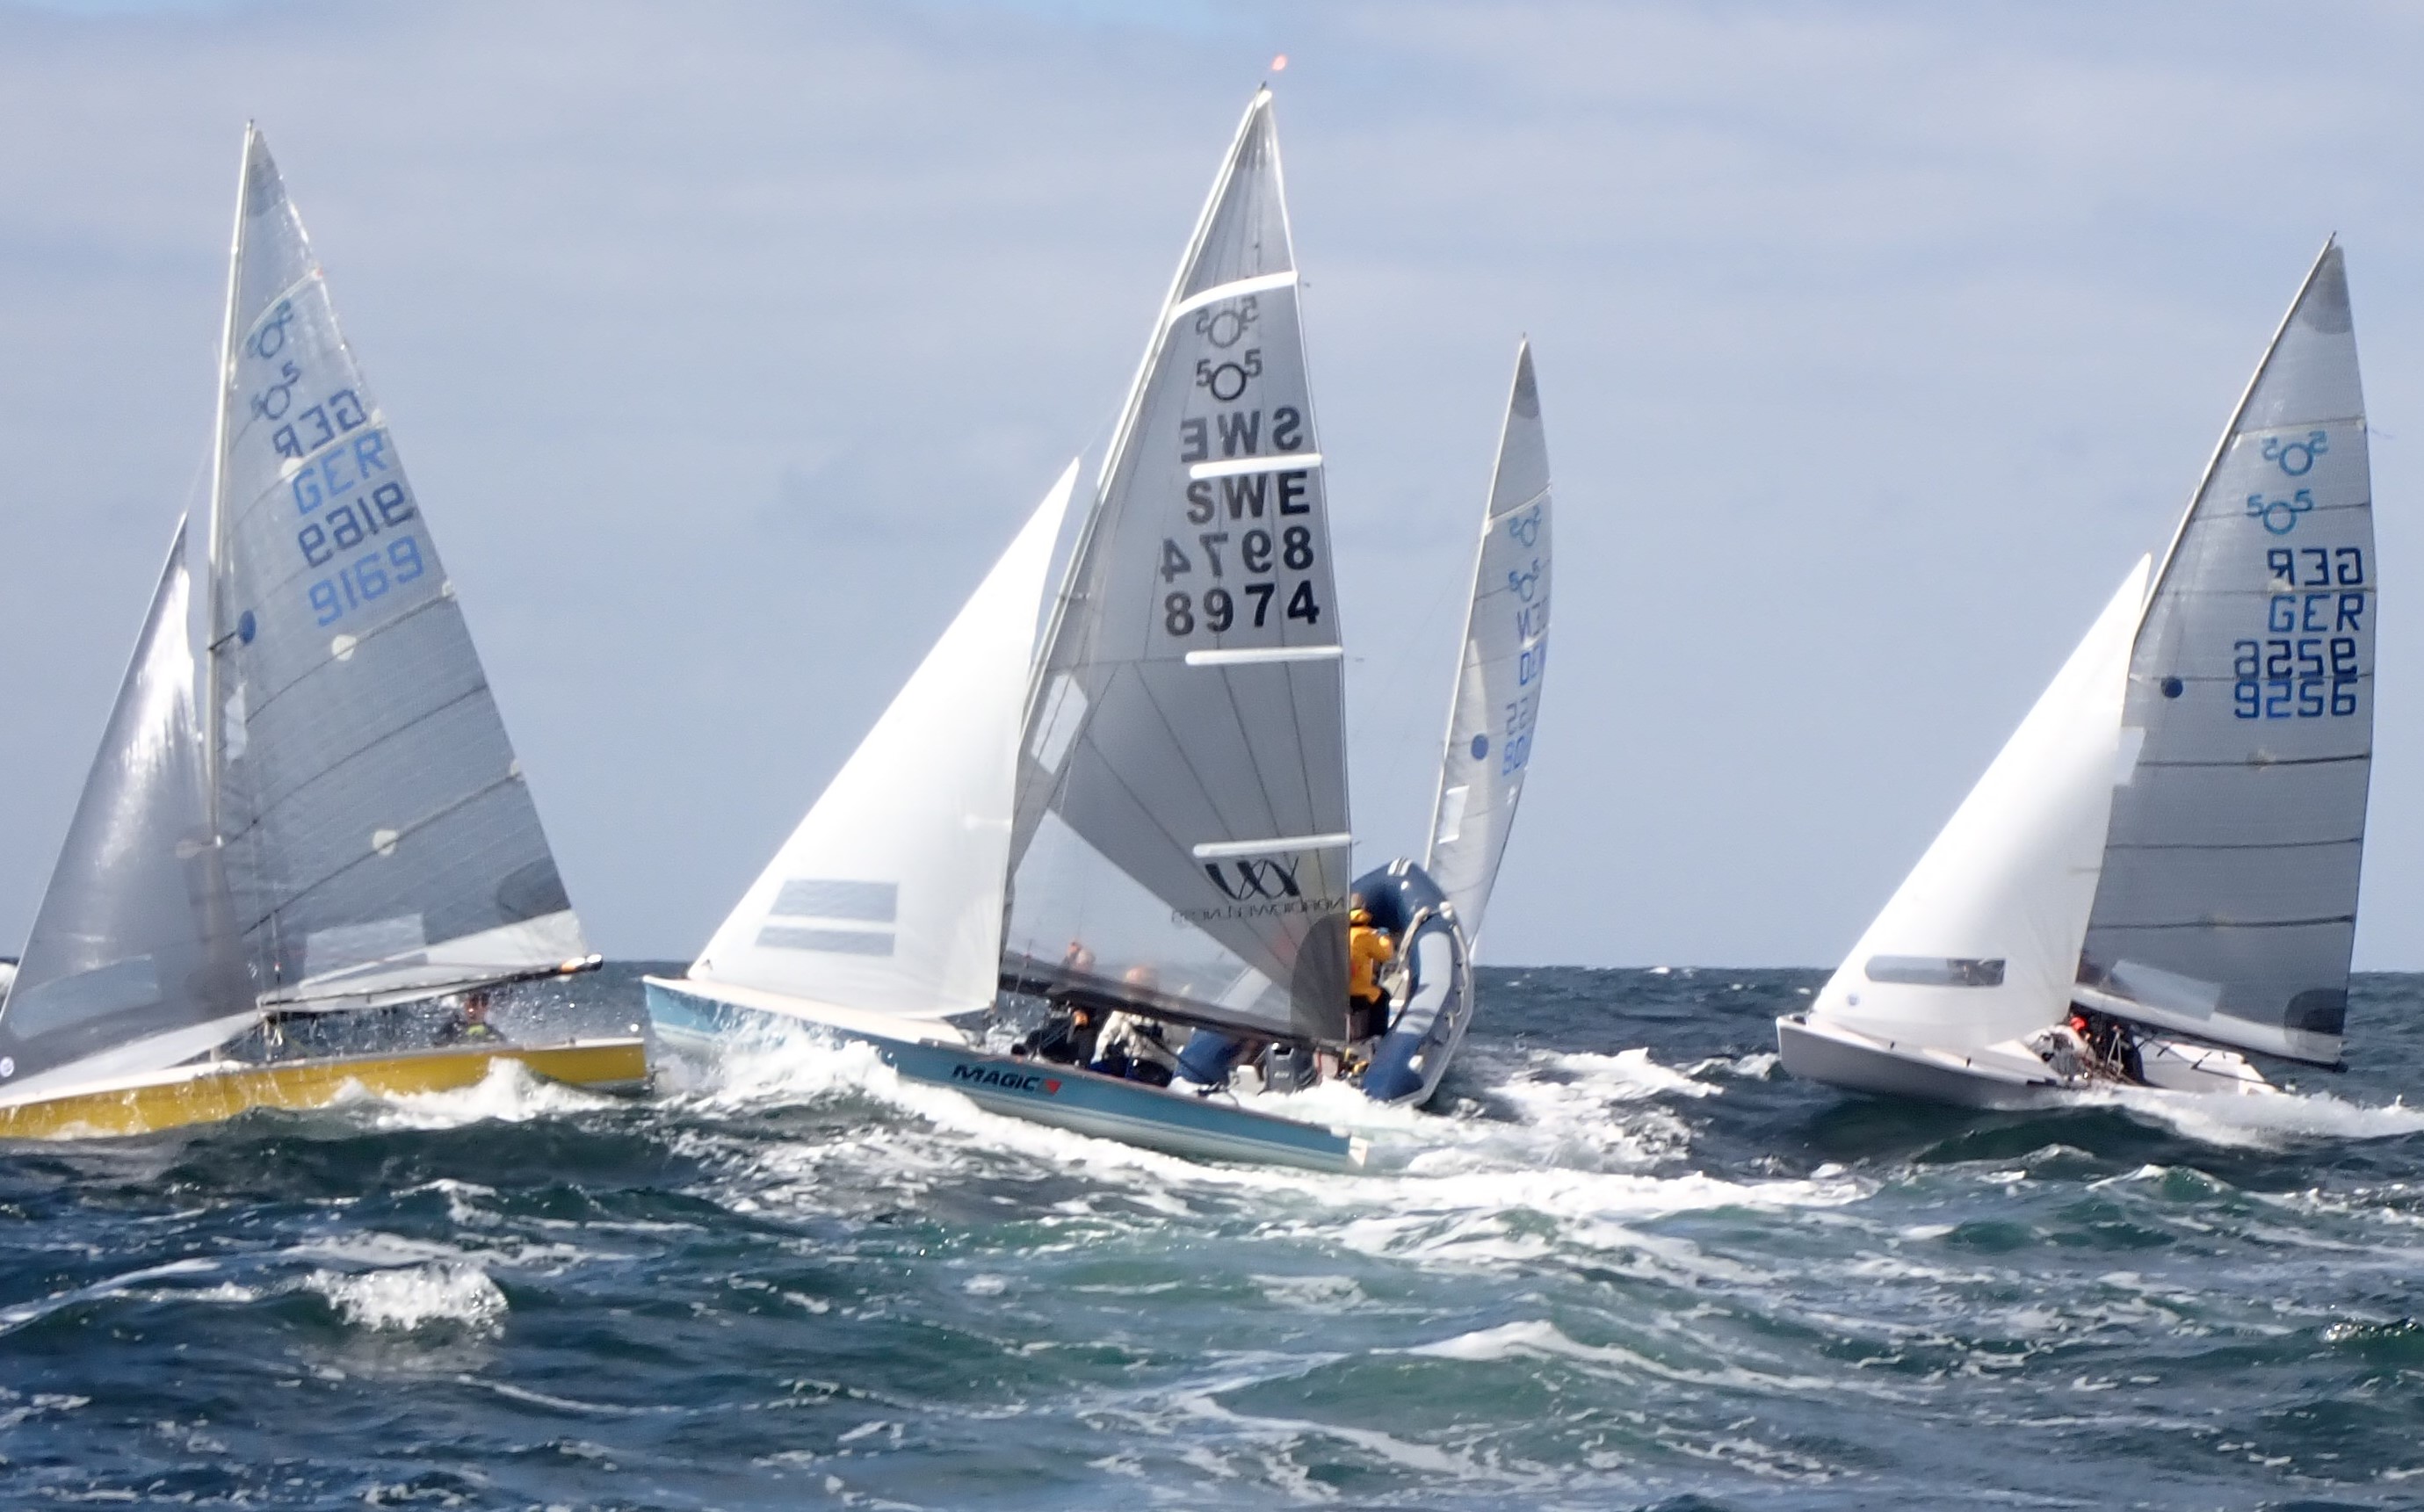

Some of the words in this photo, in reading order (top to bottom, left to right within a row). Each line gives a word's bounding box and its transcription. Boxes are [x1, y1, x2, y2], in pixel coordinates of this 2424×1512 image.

[1196, 349, 1262, 401] 505
[293, 429, 387, 515] GER
[1187, 471, 1309, 524] SWE
[2247, 488, 2312, 534] 505
[308, 535, 424, 626] 9169
[1164, 580, 1320, 636] 8974
[2268, 593, 2364, 633] GER
[2235, 678, 2358, 719] 9256
[952, 1064, 1040, 1091] MAGIC
